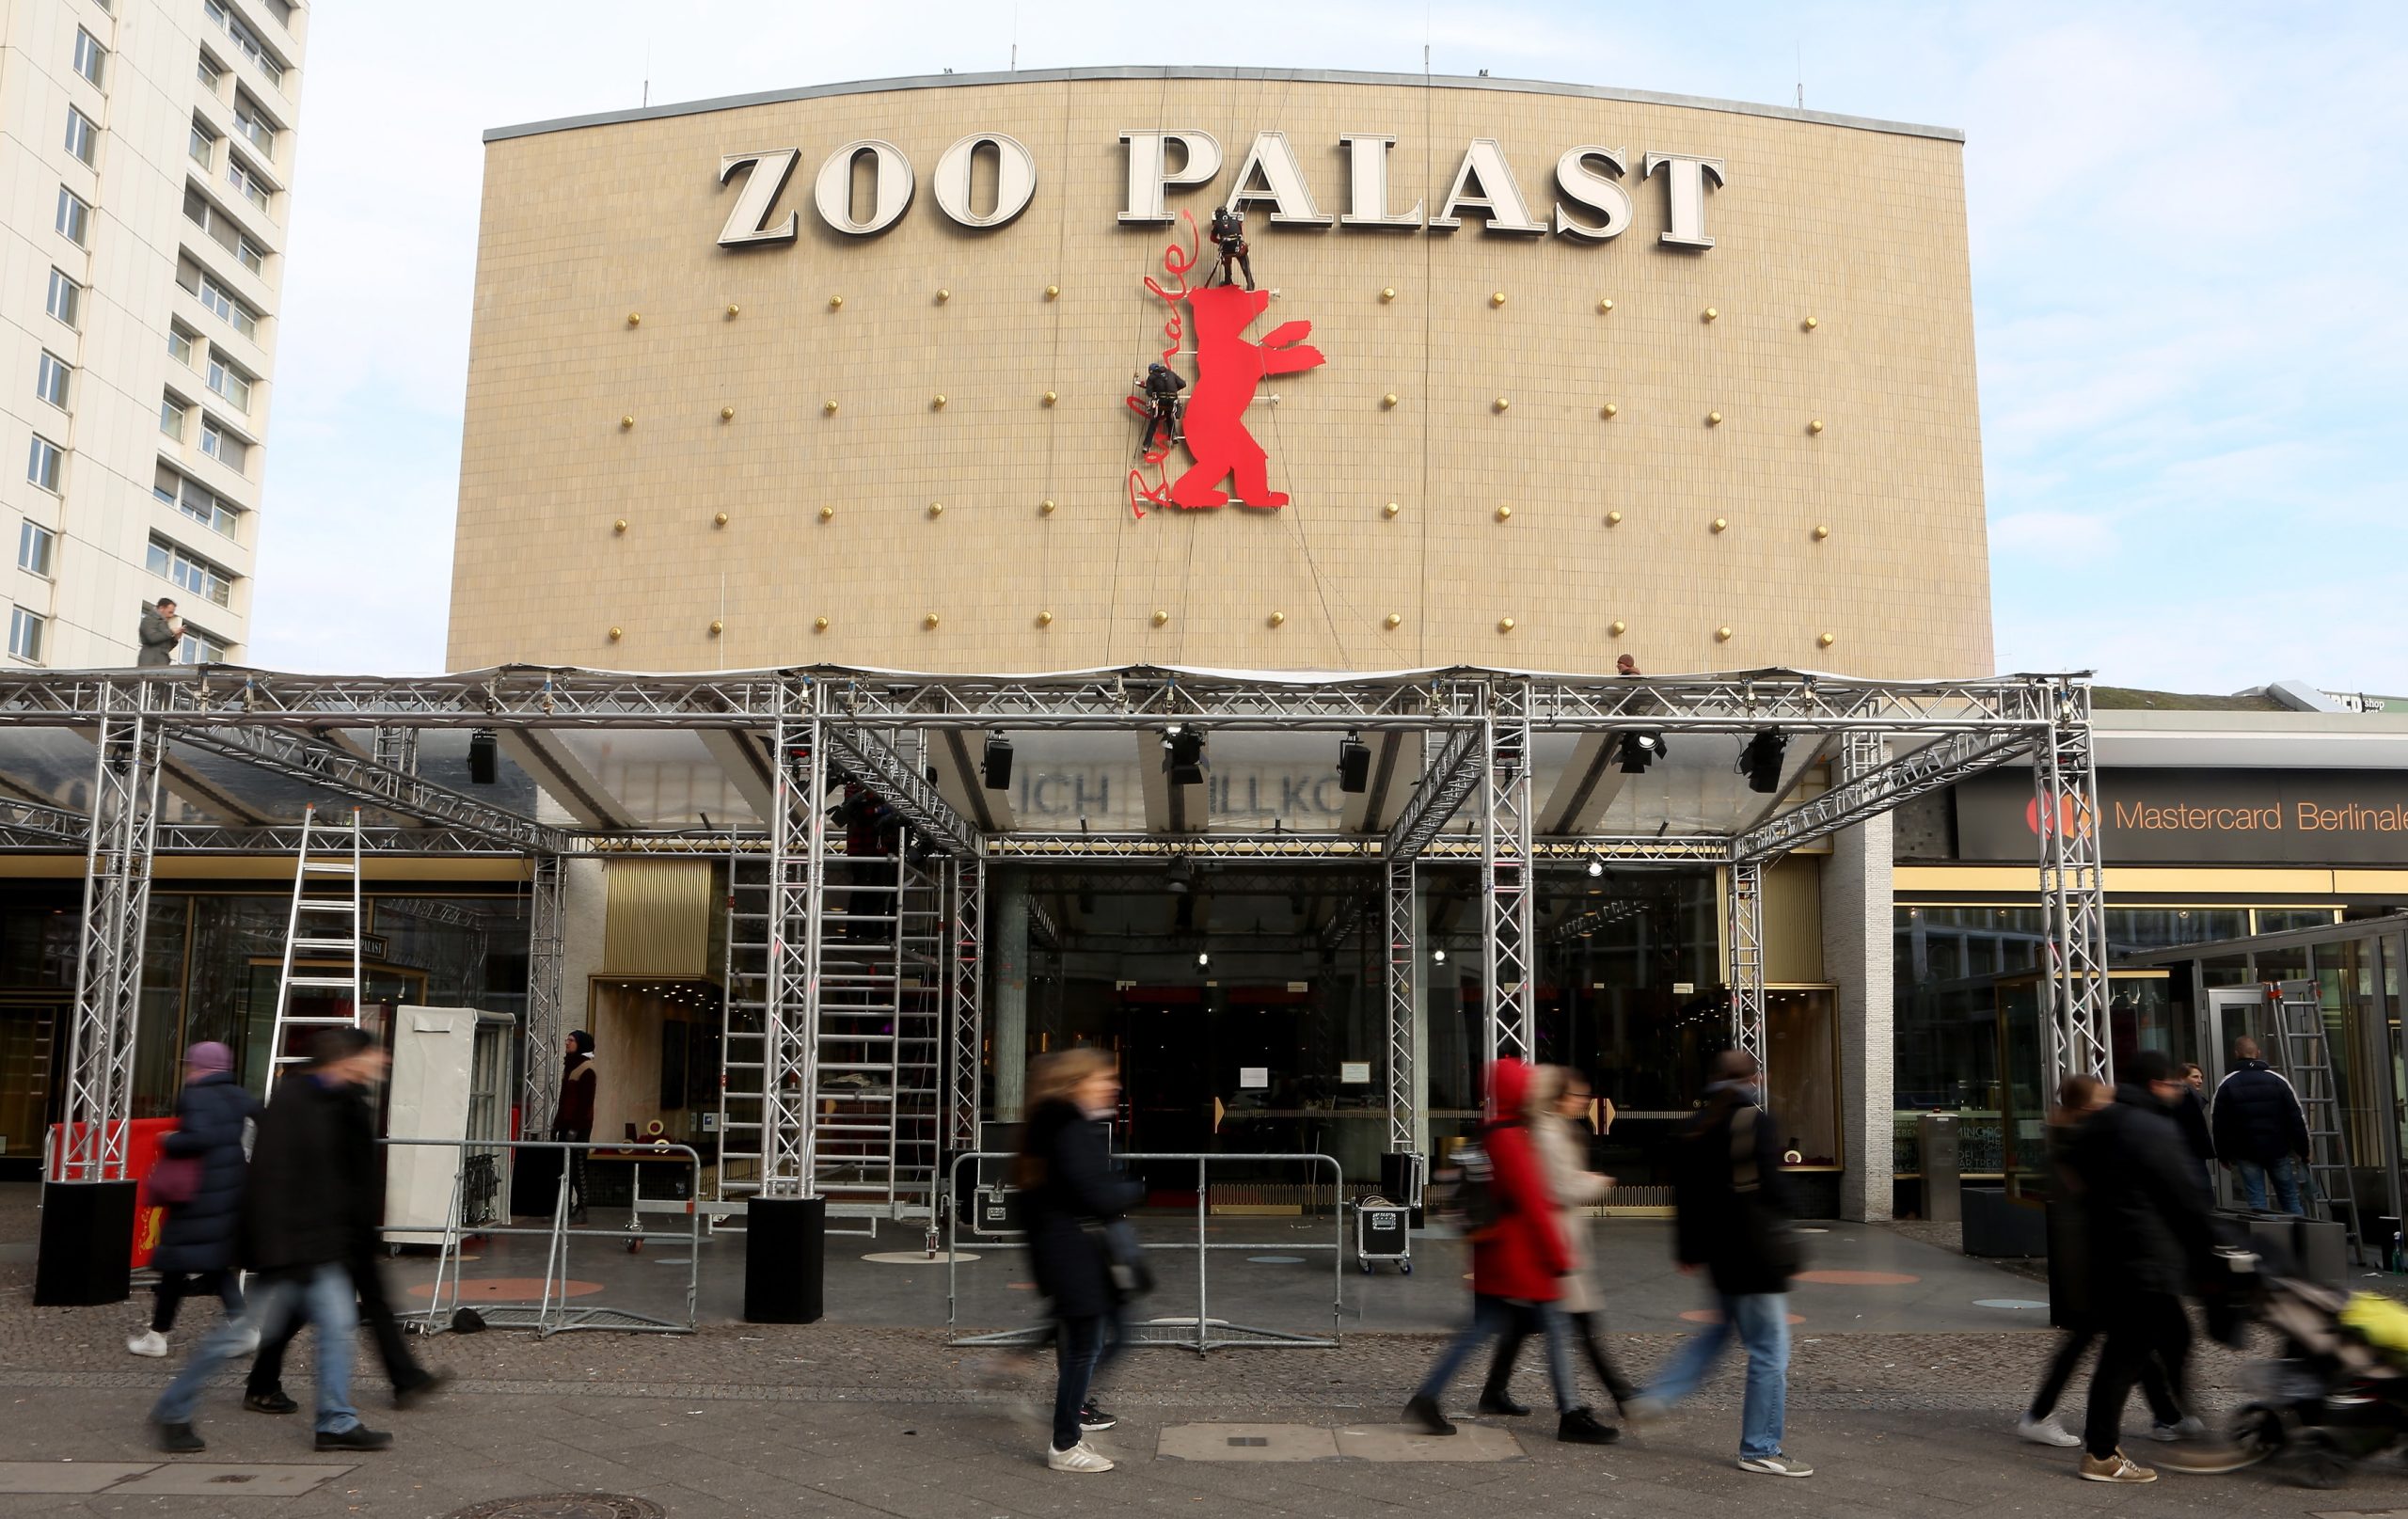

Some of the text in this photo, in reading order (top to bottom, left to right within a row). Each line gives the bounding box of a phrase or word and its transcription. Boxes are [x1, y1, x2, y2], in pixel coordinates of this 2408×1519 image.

[717, 129, 1724, 249] ZOO PALAST
[2364, 698, 2384, 711] shop
[1014, 773, 1109, 815] ICH
[2115, 800, 2408, 831] Mastercard Berlinal
